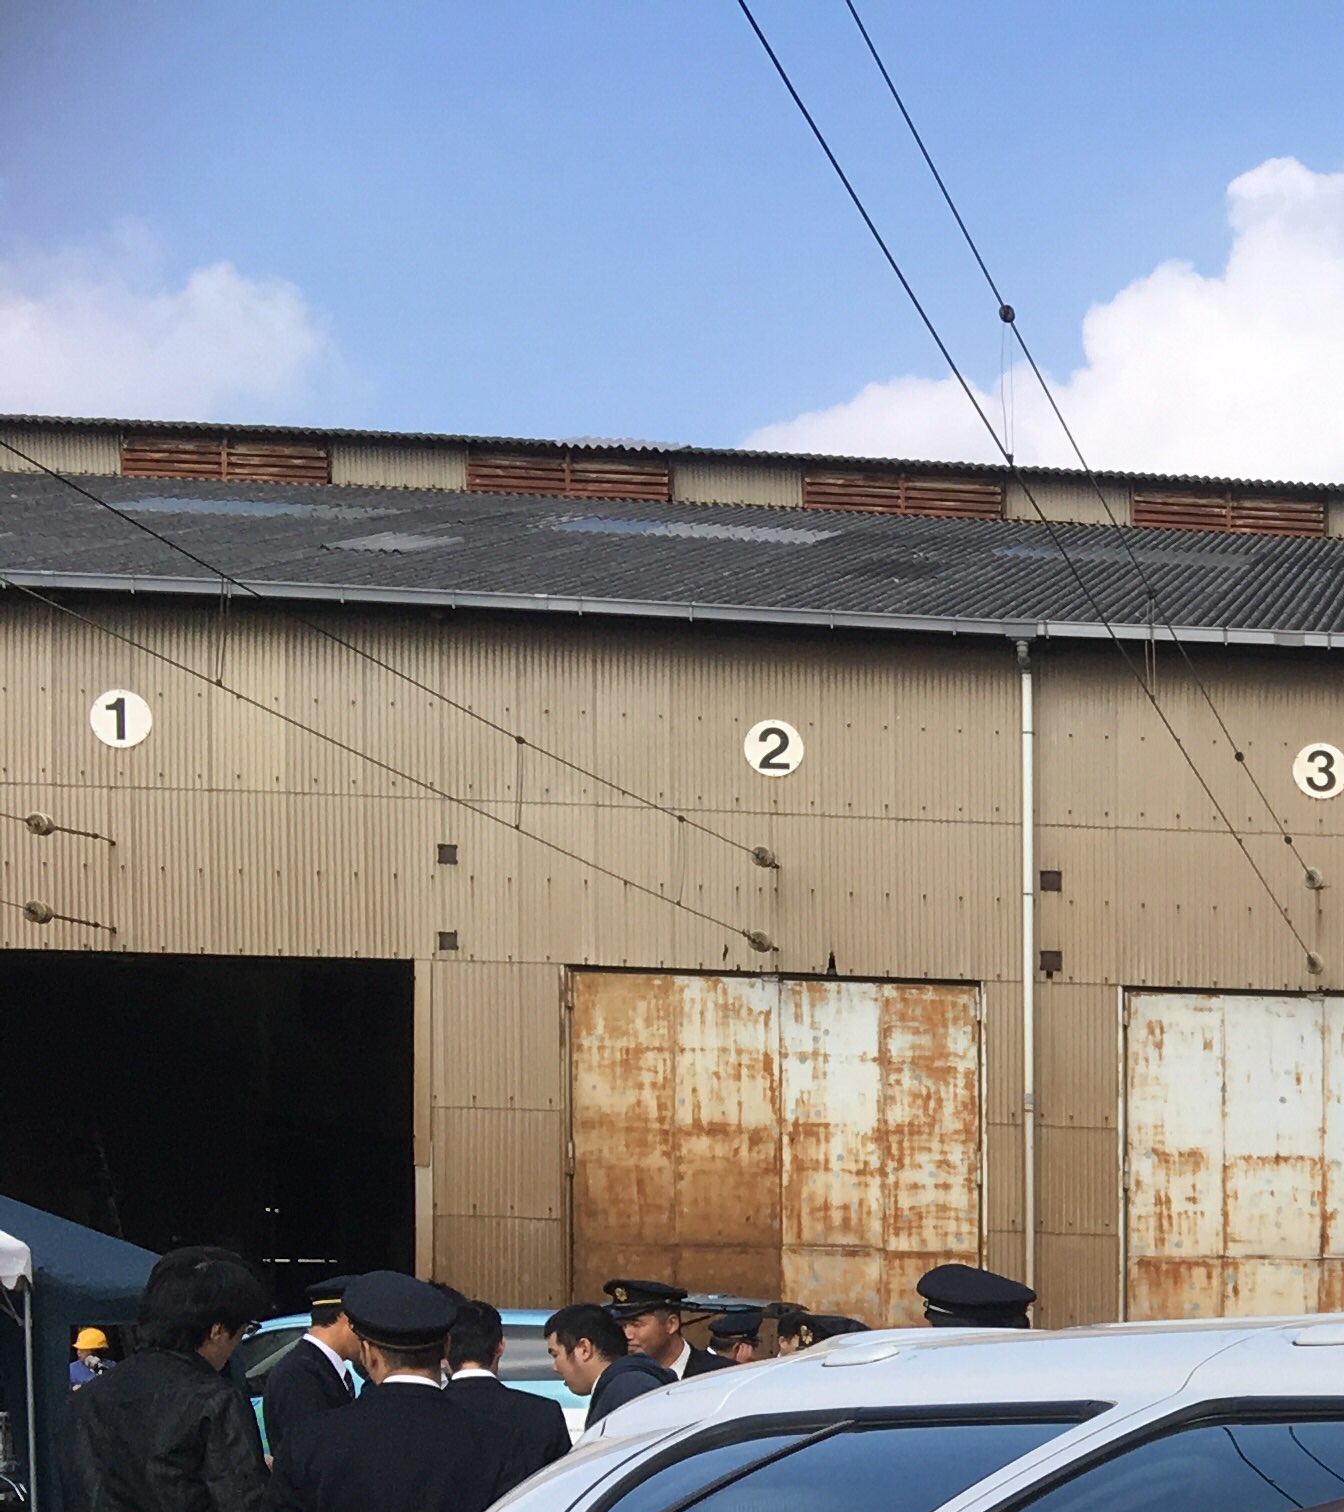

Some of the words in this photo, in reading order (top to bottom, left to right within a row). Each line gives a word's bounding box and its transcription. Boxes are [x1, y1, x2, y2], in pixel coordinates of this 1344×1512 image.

[104, 698, 127, 741] 1
[757, 727, 790, 771] 2
[1305, 751, 1336, 793] 3
